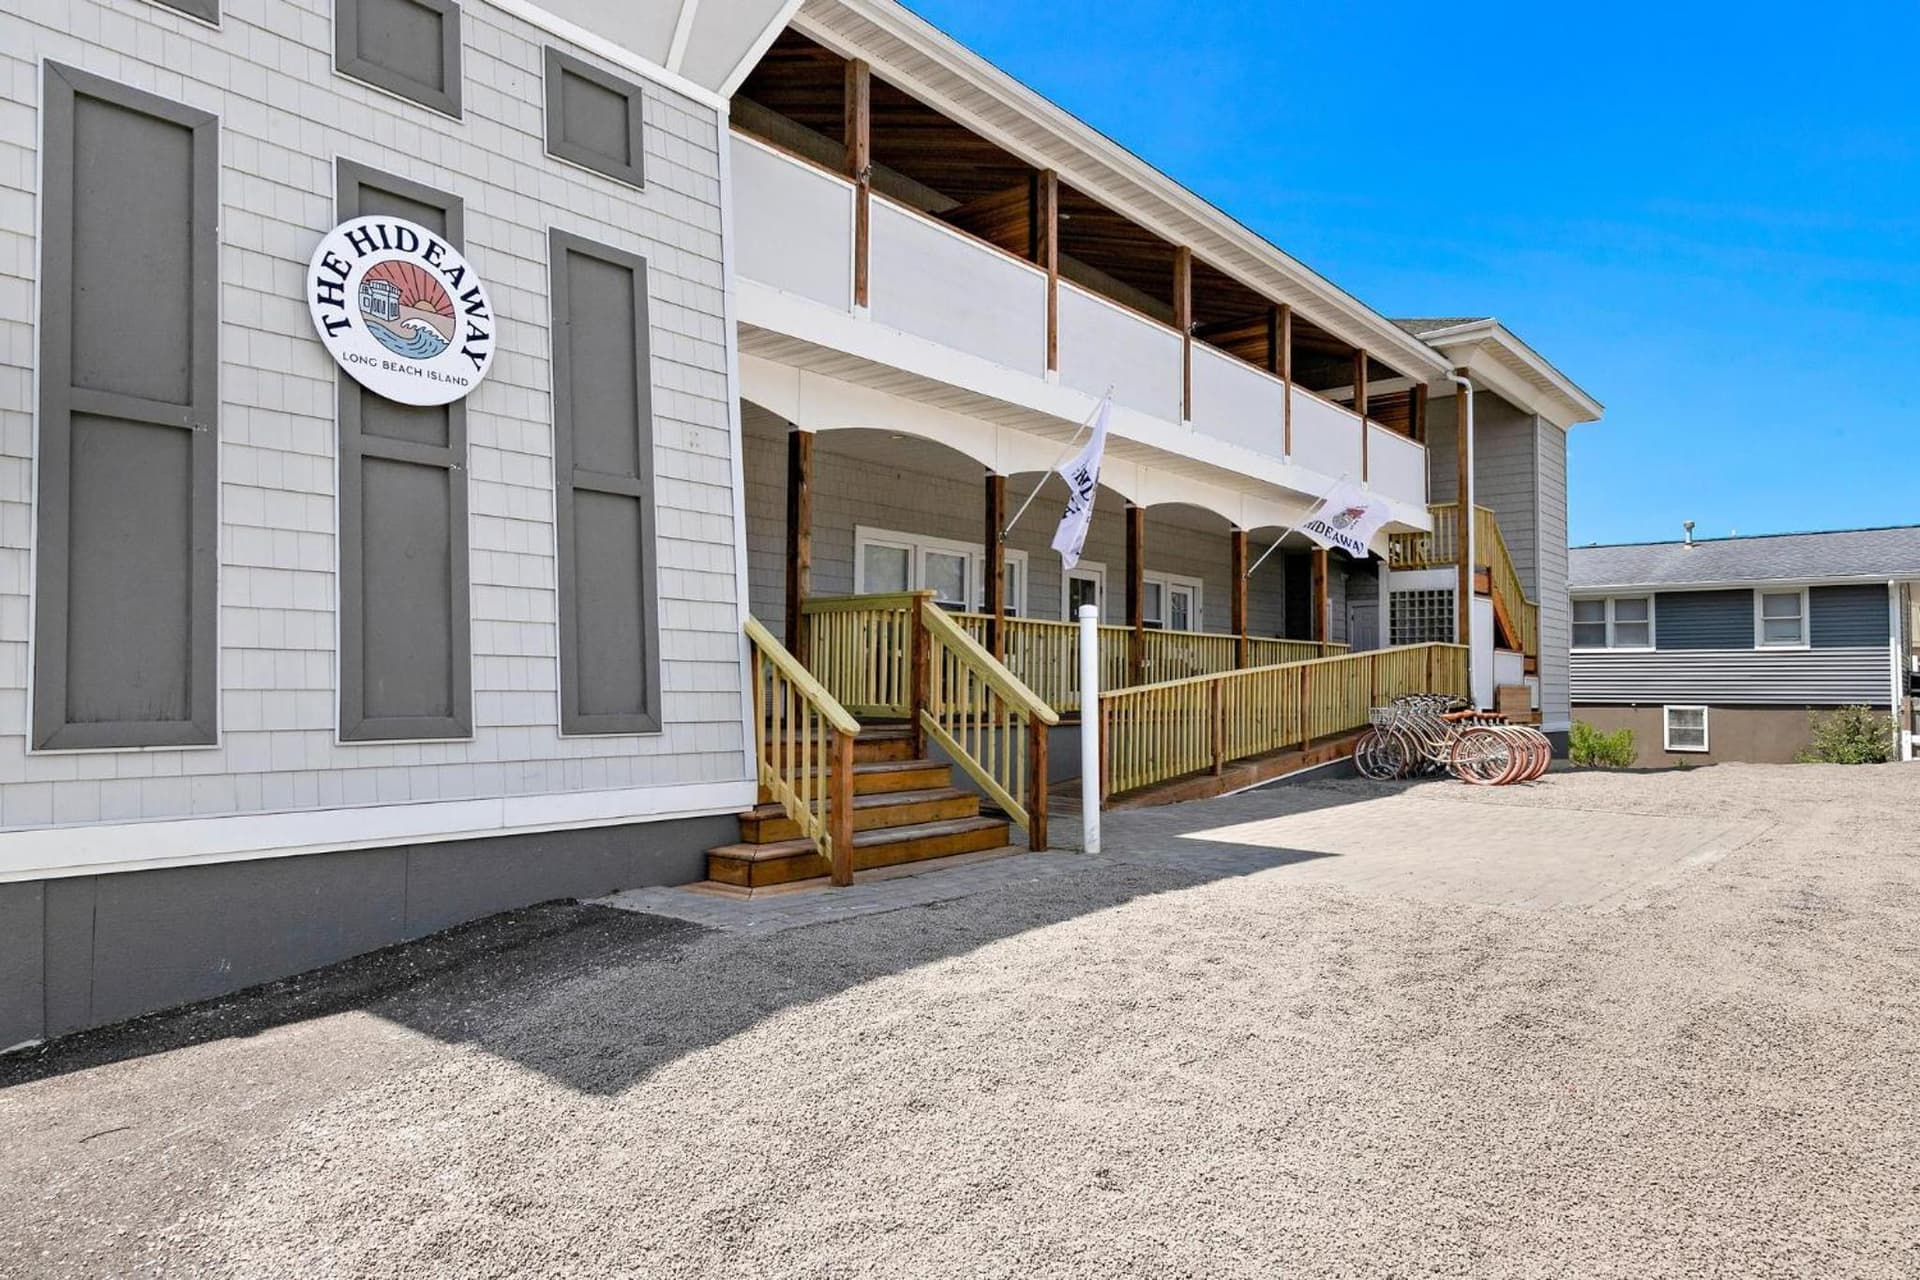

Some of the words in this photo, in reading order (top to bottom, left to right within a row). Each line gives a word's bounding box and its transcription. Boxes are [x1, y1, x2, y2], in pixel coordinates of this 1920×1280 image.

[317, 251, 352, 338] THE
[344, 224, 490, 372] HIDEAWAY
[342, 351, 377, 367] LONG
[382, 360, 422, 377] BEACH
[427, 370, 469, 387] ISLAND
